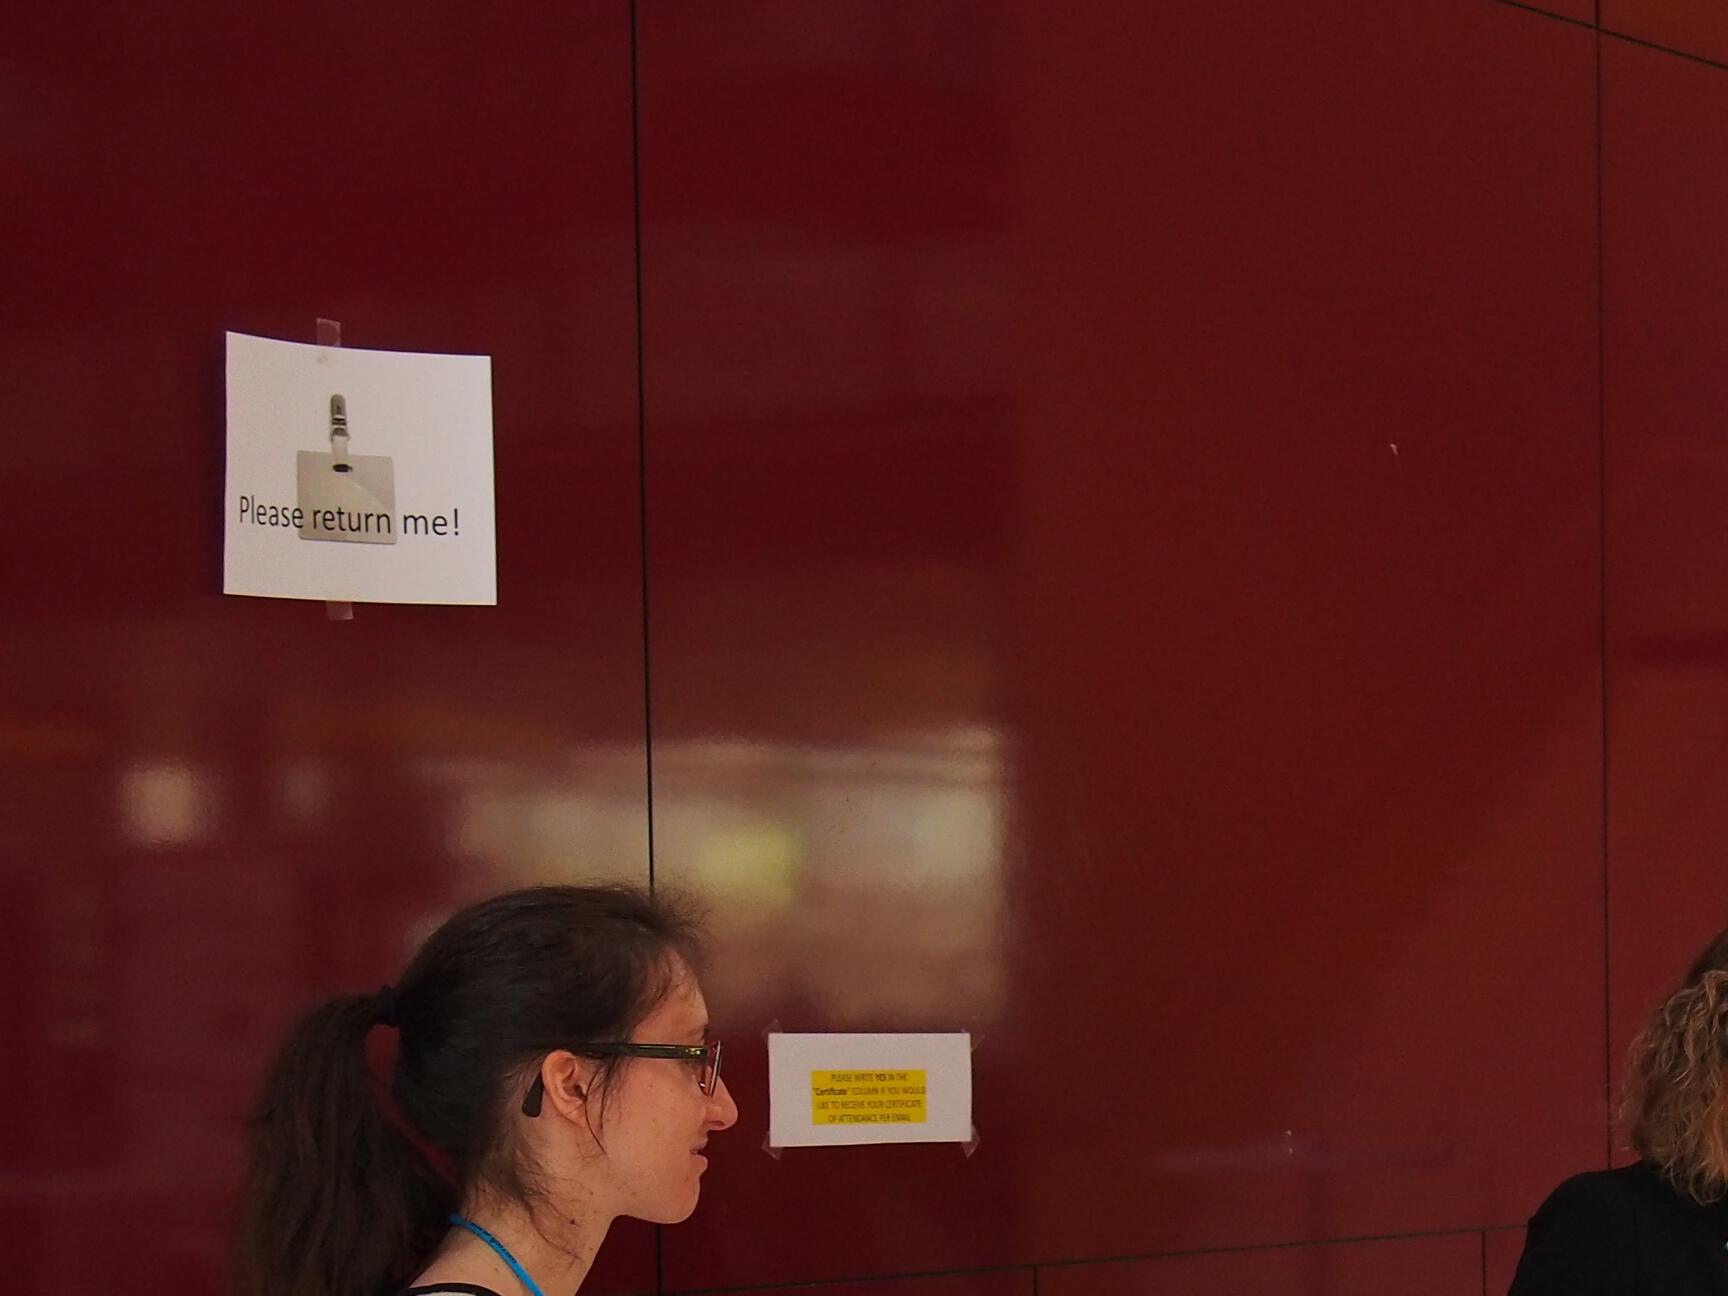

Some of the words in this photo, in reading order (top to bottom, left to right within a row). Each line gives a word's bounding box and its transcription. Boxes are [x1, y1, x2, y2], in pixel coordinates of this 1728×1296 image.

[239, 495, 304, 529] Please
[312, 507, 391, 534] return
[403, 508, 460, 536] me!
